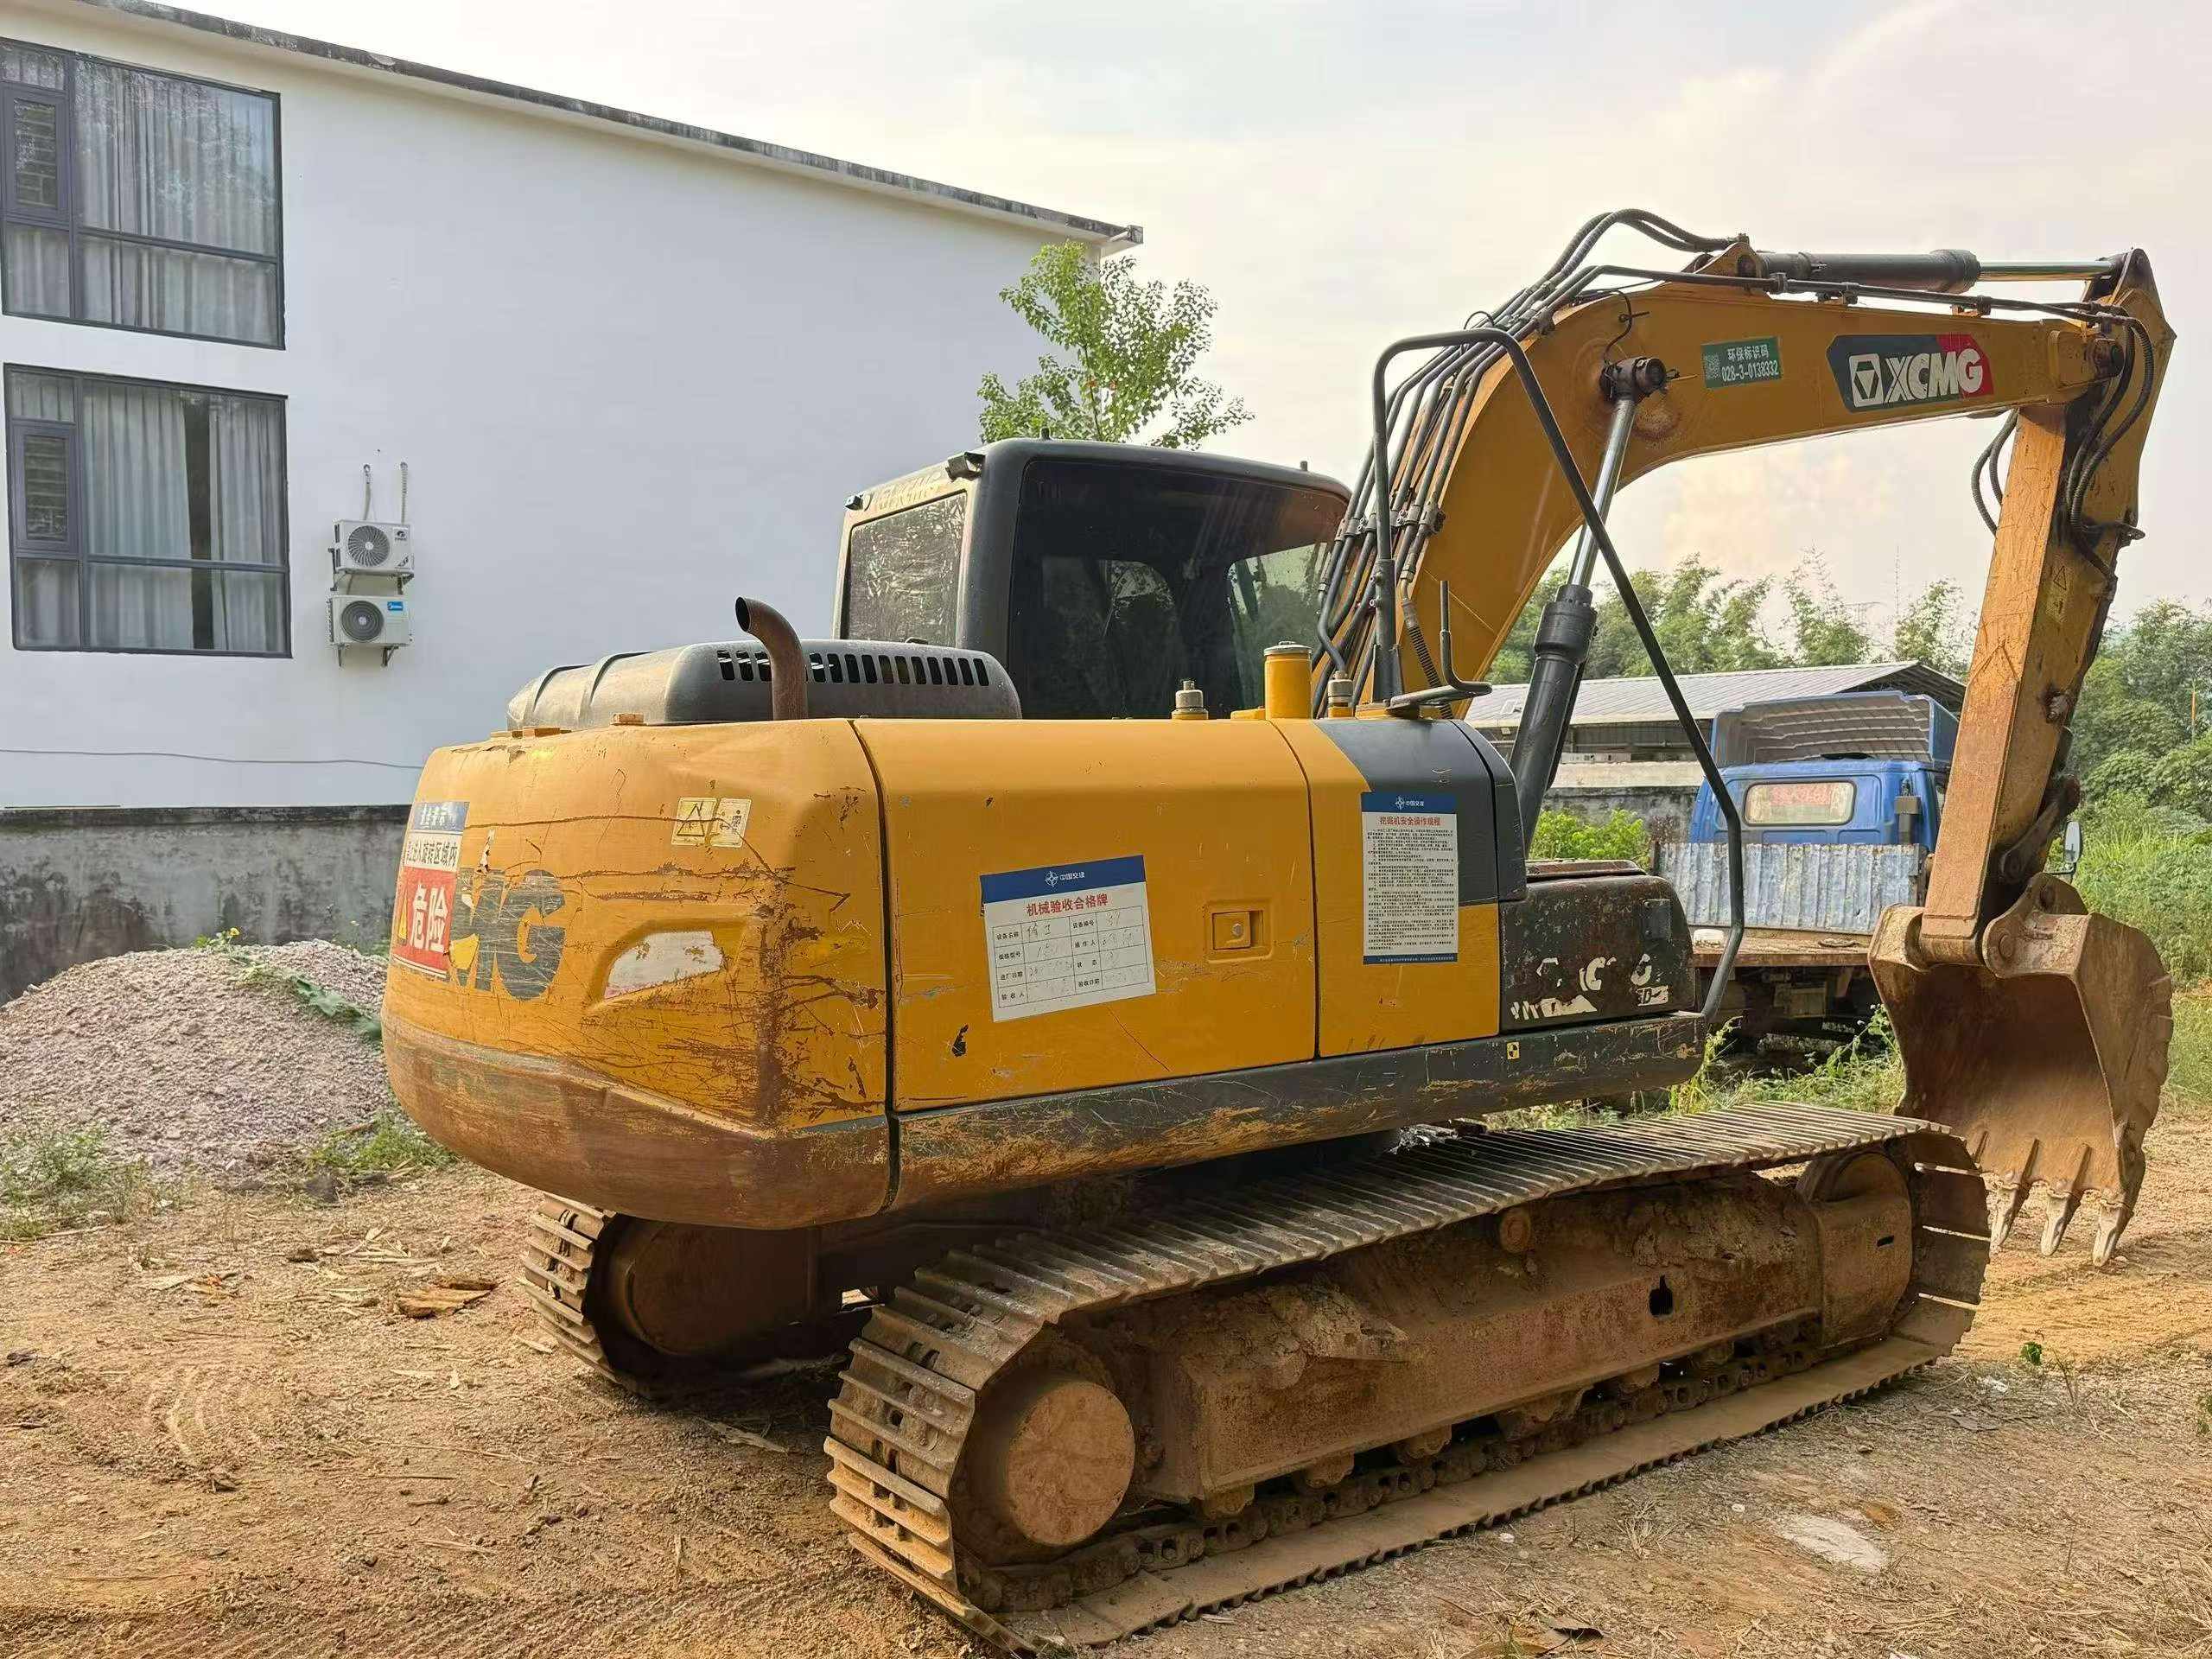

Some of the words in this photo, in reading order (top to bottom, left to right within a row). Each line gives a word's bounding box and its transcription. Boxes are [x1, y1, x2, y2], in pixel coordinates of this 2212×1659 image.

[1728, 344, 1769, 361] 环保标识码
[1721, 360, 1779, 382] 028-3-0138332
[1885, 348, 1984, 404] XCMG
[1380, 816, 1441, 826] 挖掘机安全操作规程
[1059, 871, 1085, 880] 中国交建
[1026, 893, 1108, 916] 机械验收合格牌
[410, 880, 449, 952] 危险
